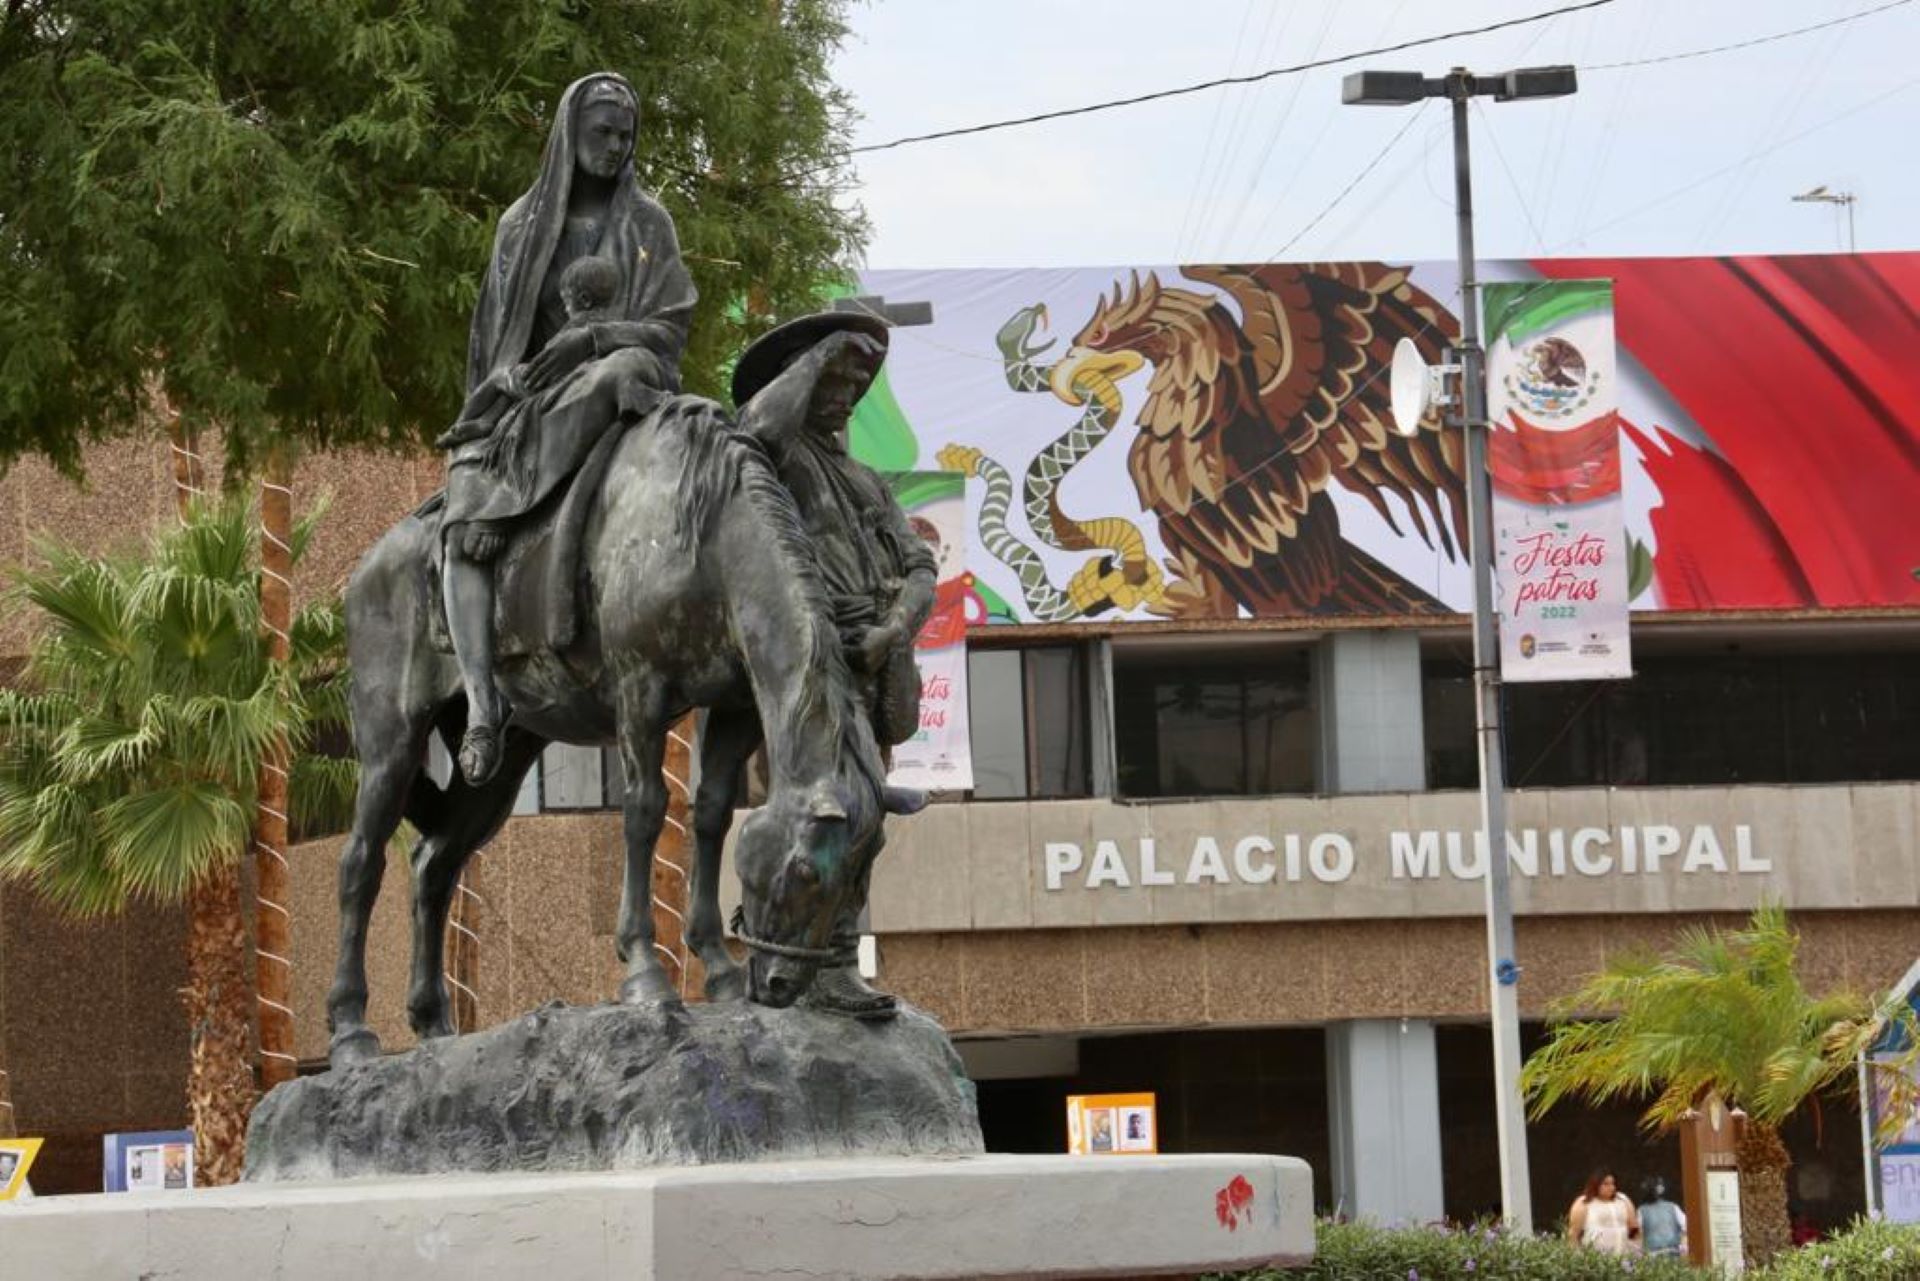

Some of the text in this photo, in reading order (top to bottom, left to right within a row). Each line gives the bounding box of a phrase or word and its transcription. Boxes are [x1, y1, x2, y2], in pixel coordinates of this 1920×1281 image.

[1514, 532, 1605, 576] Fiestas
[1514, 568, 1598, 617] patrias
[1541, 606, 1576, 618] 2022
[1045, 825, 1772, 890] PALACIO MUNICIPAL
